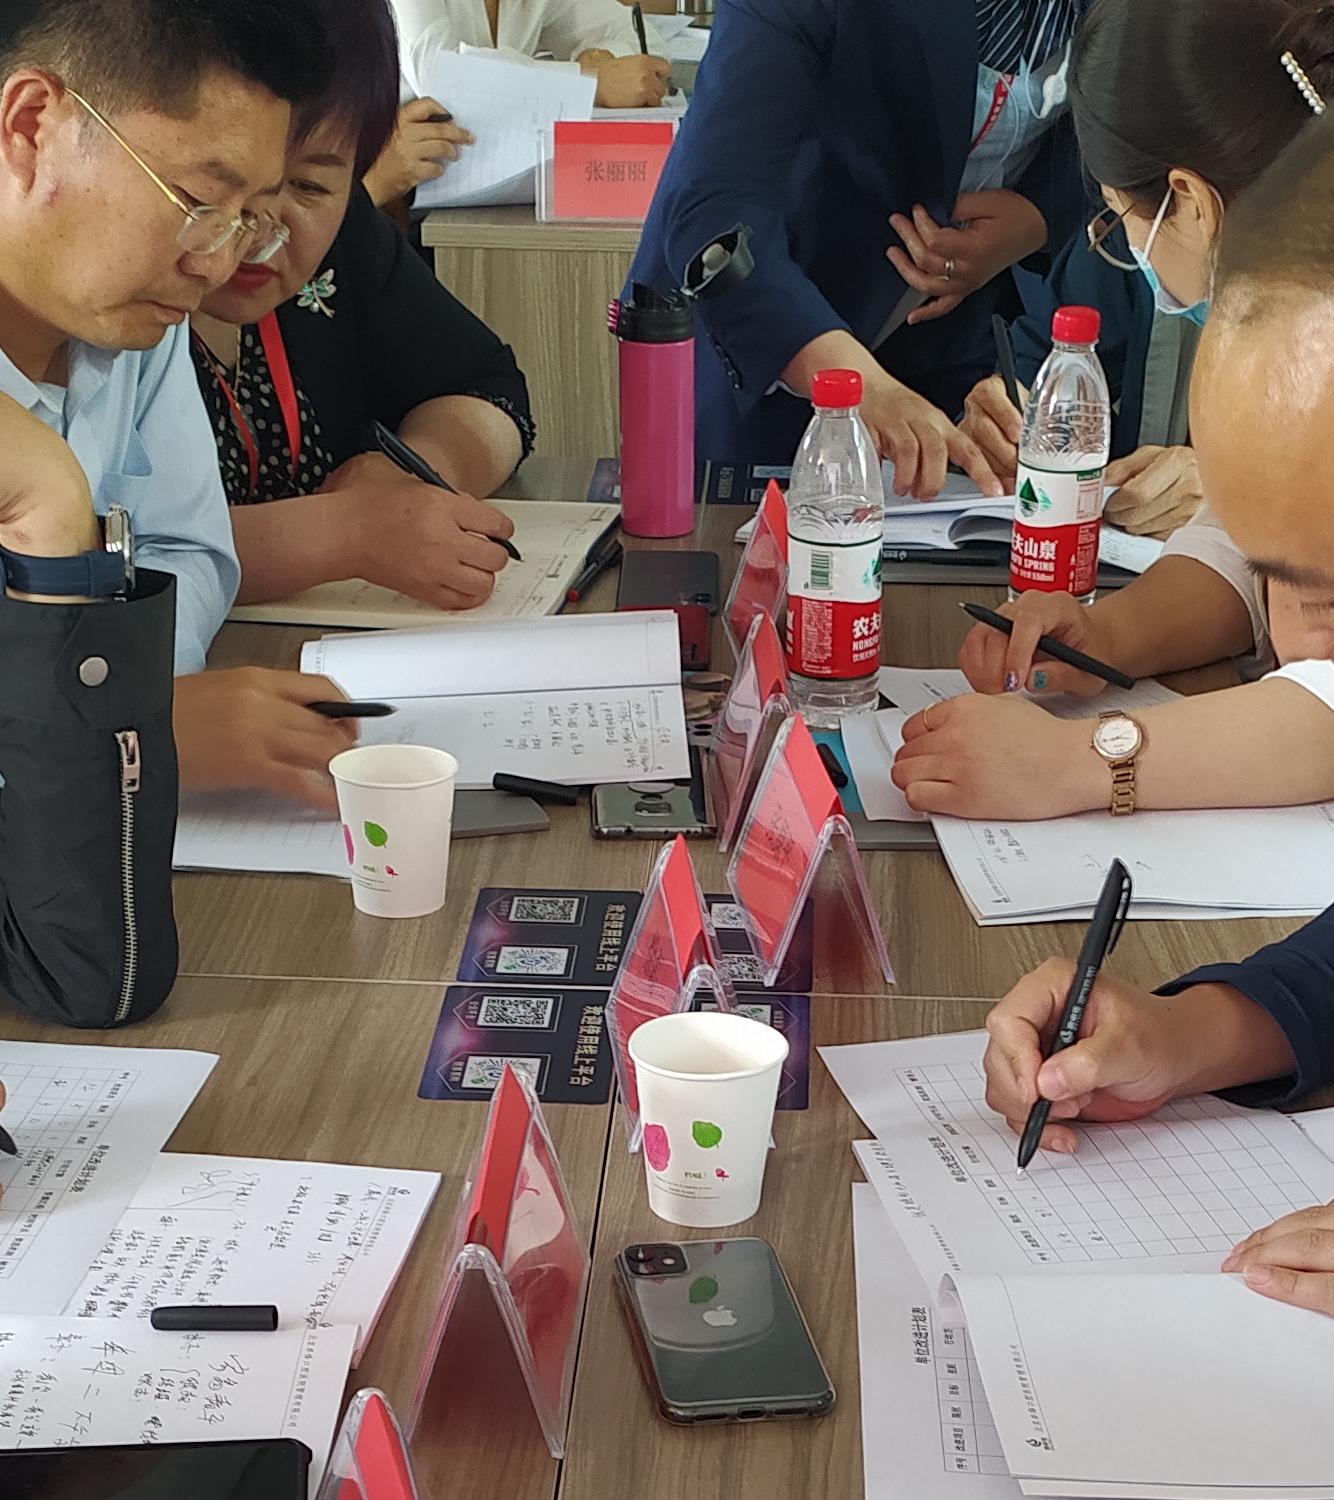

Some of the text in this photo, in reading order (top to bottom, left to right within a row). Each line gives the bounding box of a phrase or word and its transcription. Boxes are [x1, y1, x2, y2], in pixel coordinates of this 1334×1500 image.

[585, 161, 647, 182] 张丽丽
[569, 1004, 605, 1087] 欢迎使用线上平台
[910, 1306, 932, 1366] 单位改进计划表
